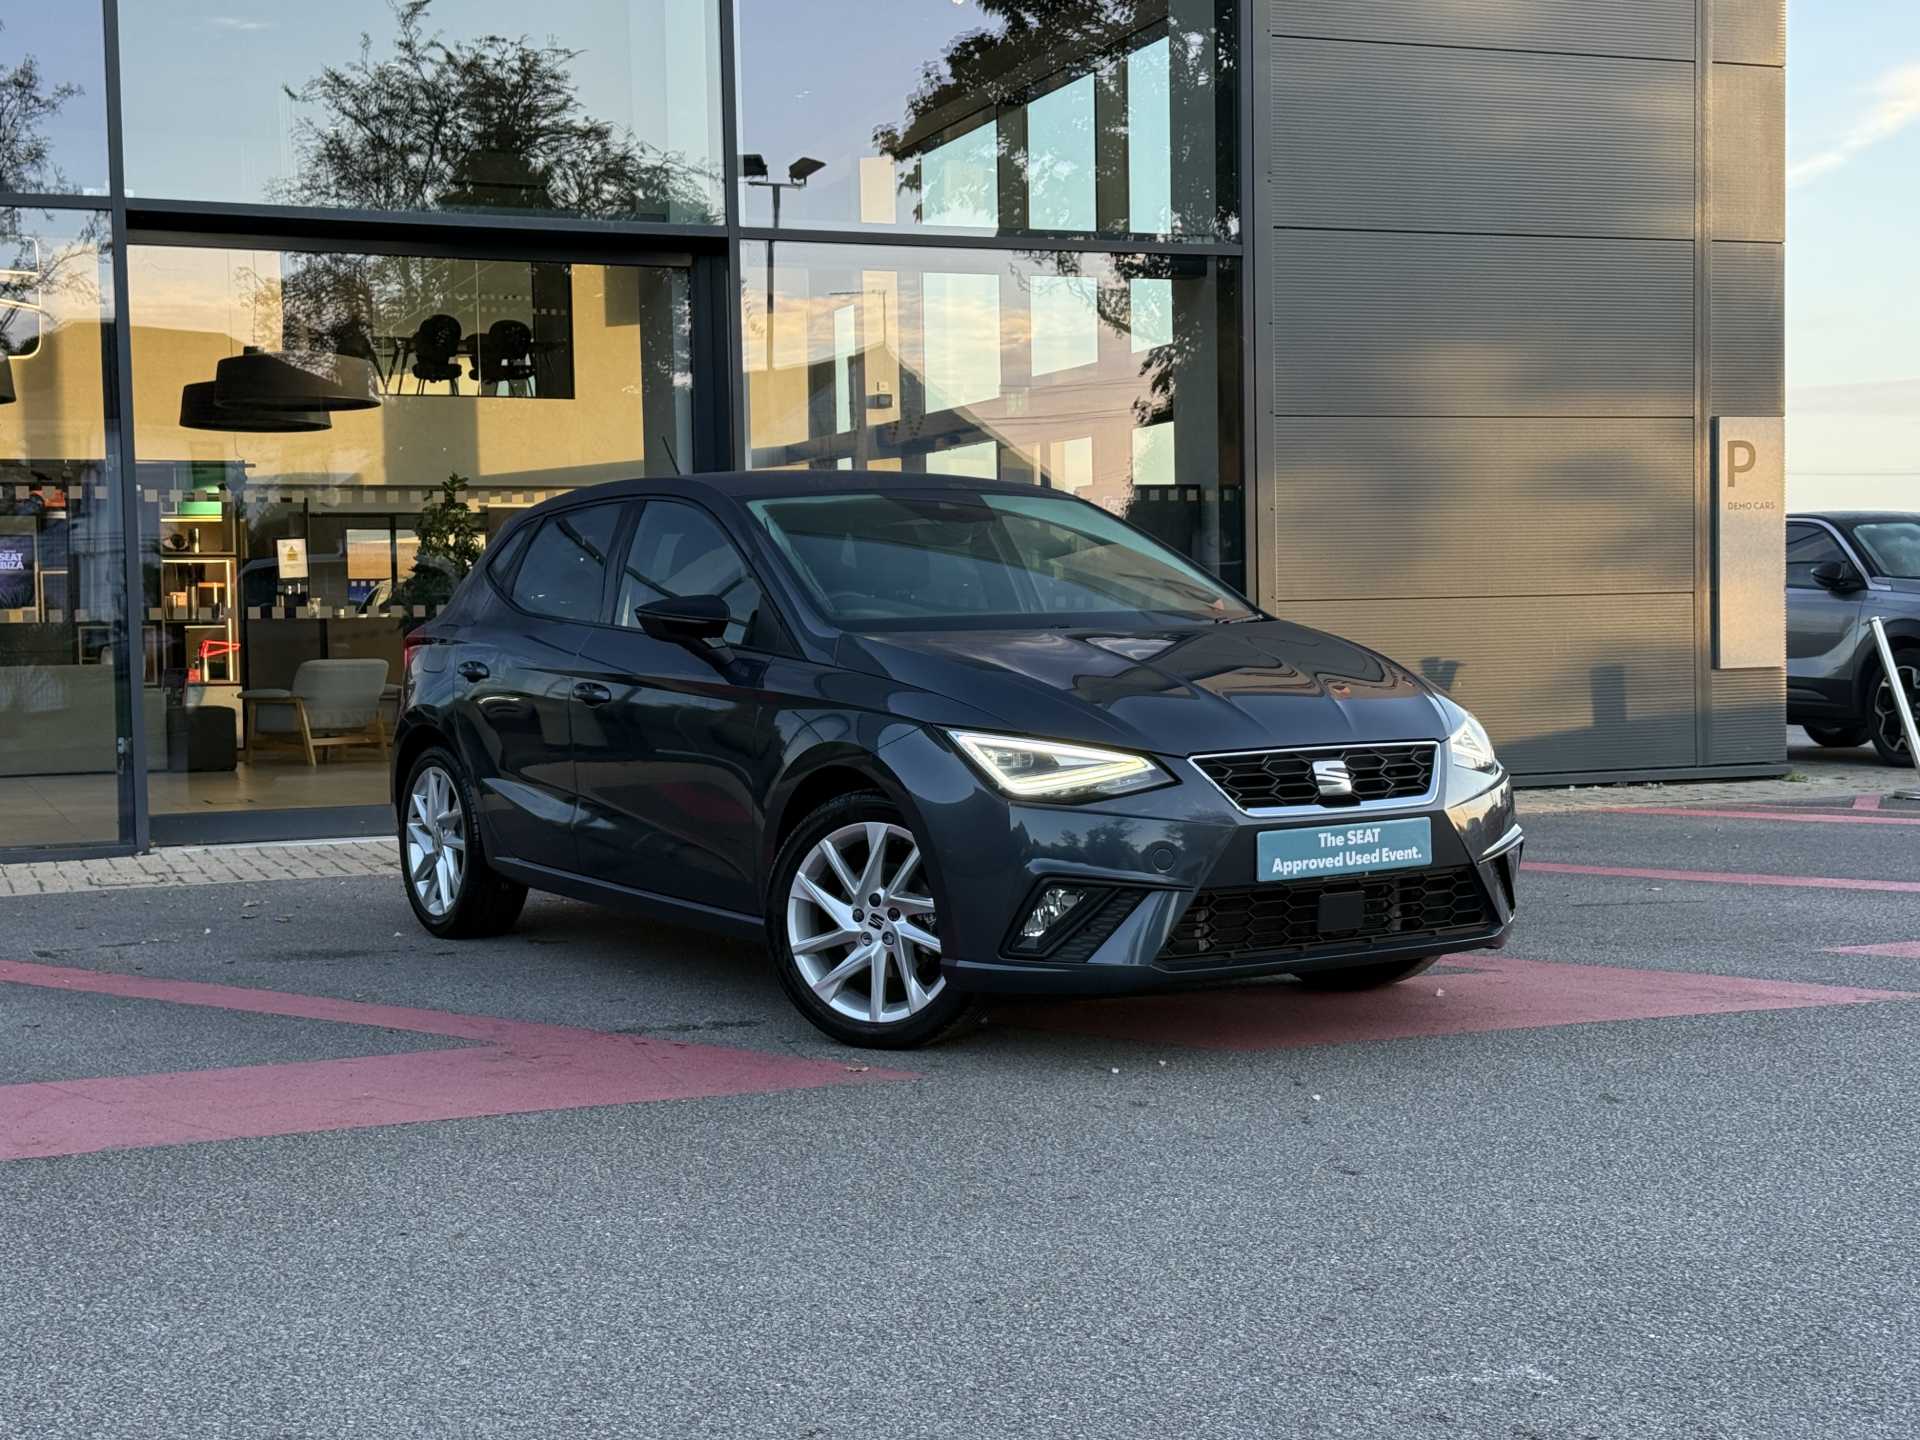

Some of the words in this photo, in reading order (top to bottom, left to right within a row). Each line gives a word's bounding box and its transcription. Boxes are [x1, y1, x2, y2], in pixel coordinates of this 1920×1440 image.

[1728, 441, 1756, 487] P
[1728, 502, 1752, 510] DEMO
[1753, 501, 1775, 510] CARS
[1318, 832, 1345, 848] The
[1347, 828, 1381, 845] SEAT
[1272, 852, 1344, 875] Approved
[1345, 848, 1379, 866] Used
[1382, 846, 1422, 862] Event.
